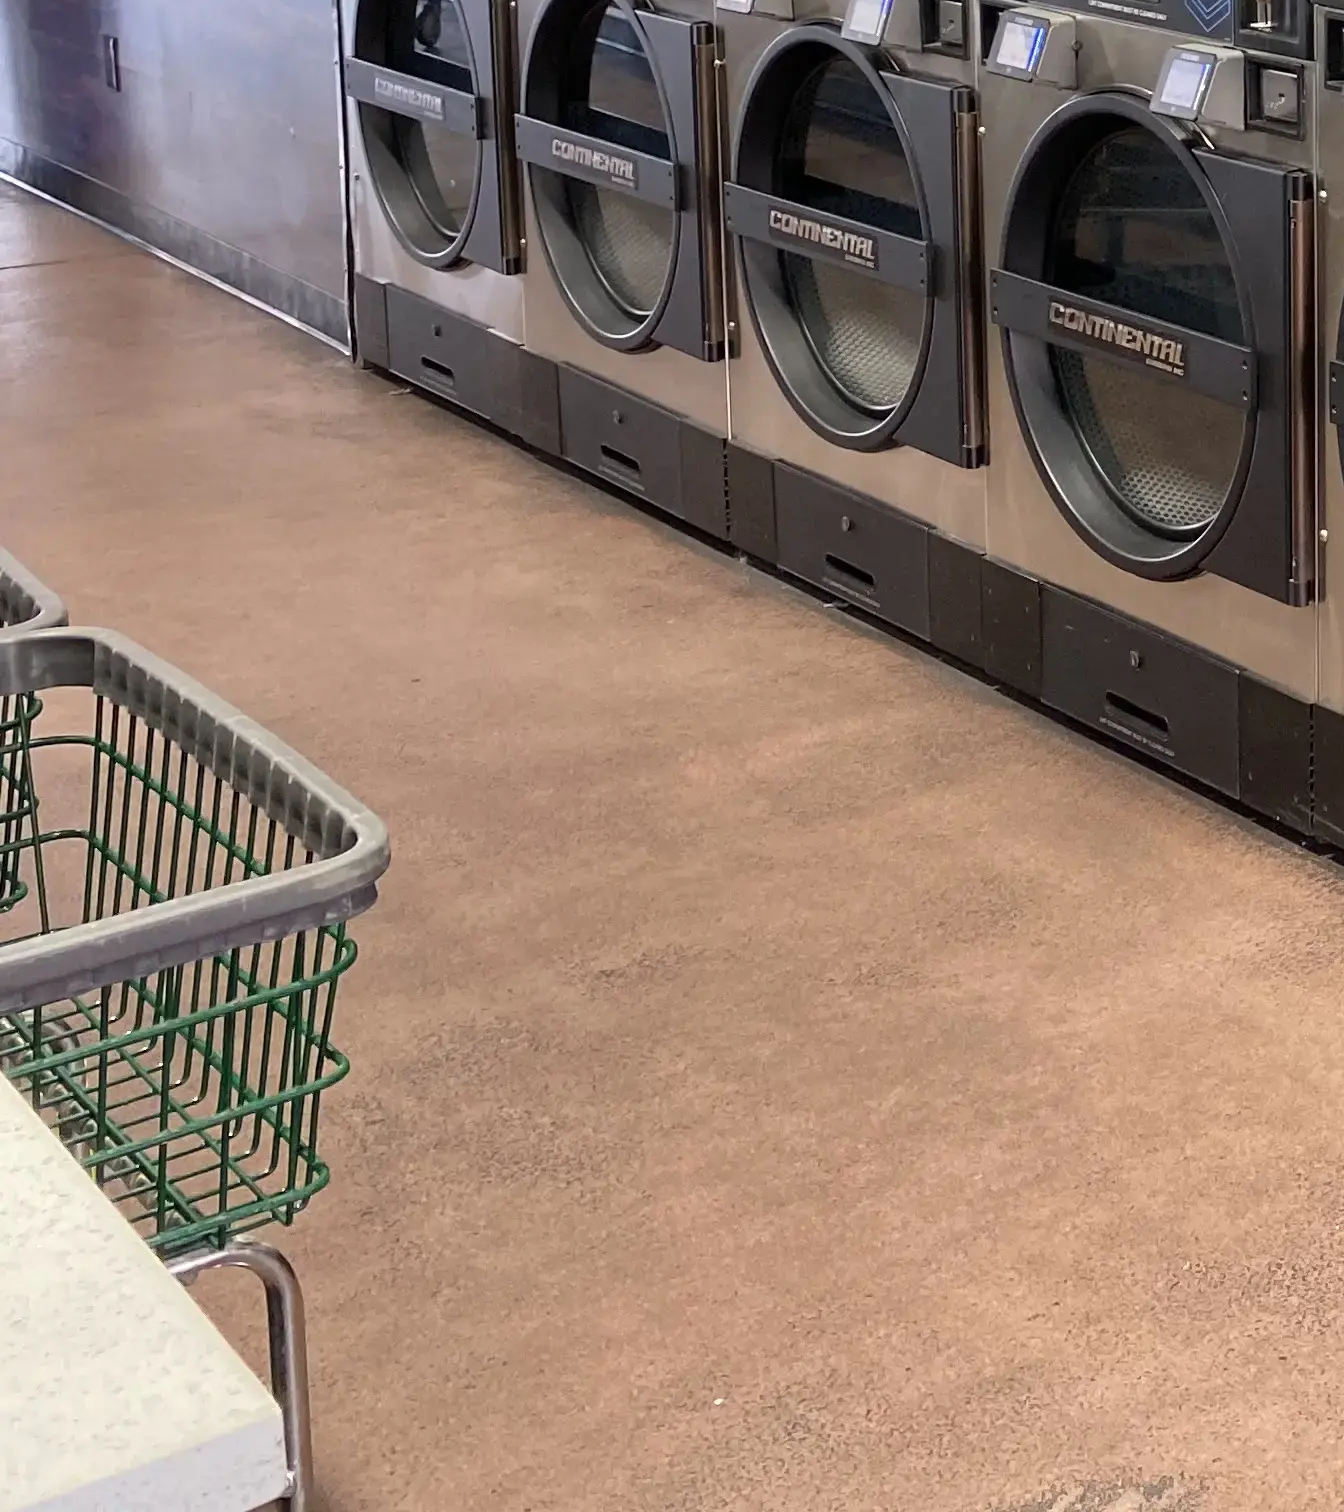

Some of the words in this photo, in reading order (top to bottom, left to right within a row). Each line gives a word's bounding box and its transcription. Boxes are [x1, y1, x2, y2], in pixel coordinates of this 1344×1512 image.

[552, 139, 635, 179] CONTINENTAL
[770, 209, 875, 260] CONTINENTAL
[1050, 302, 1184, 366] CONTINENTAL
